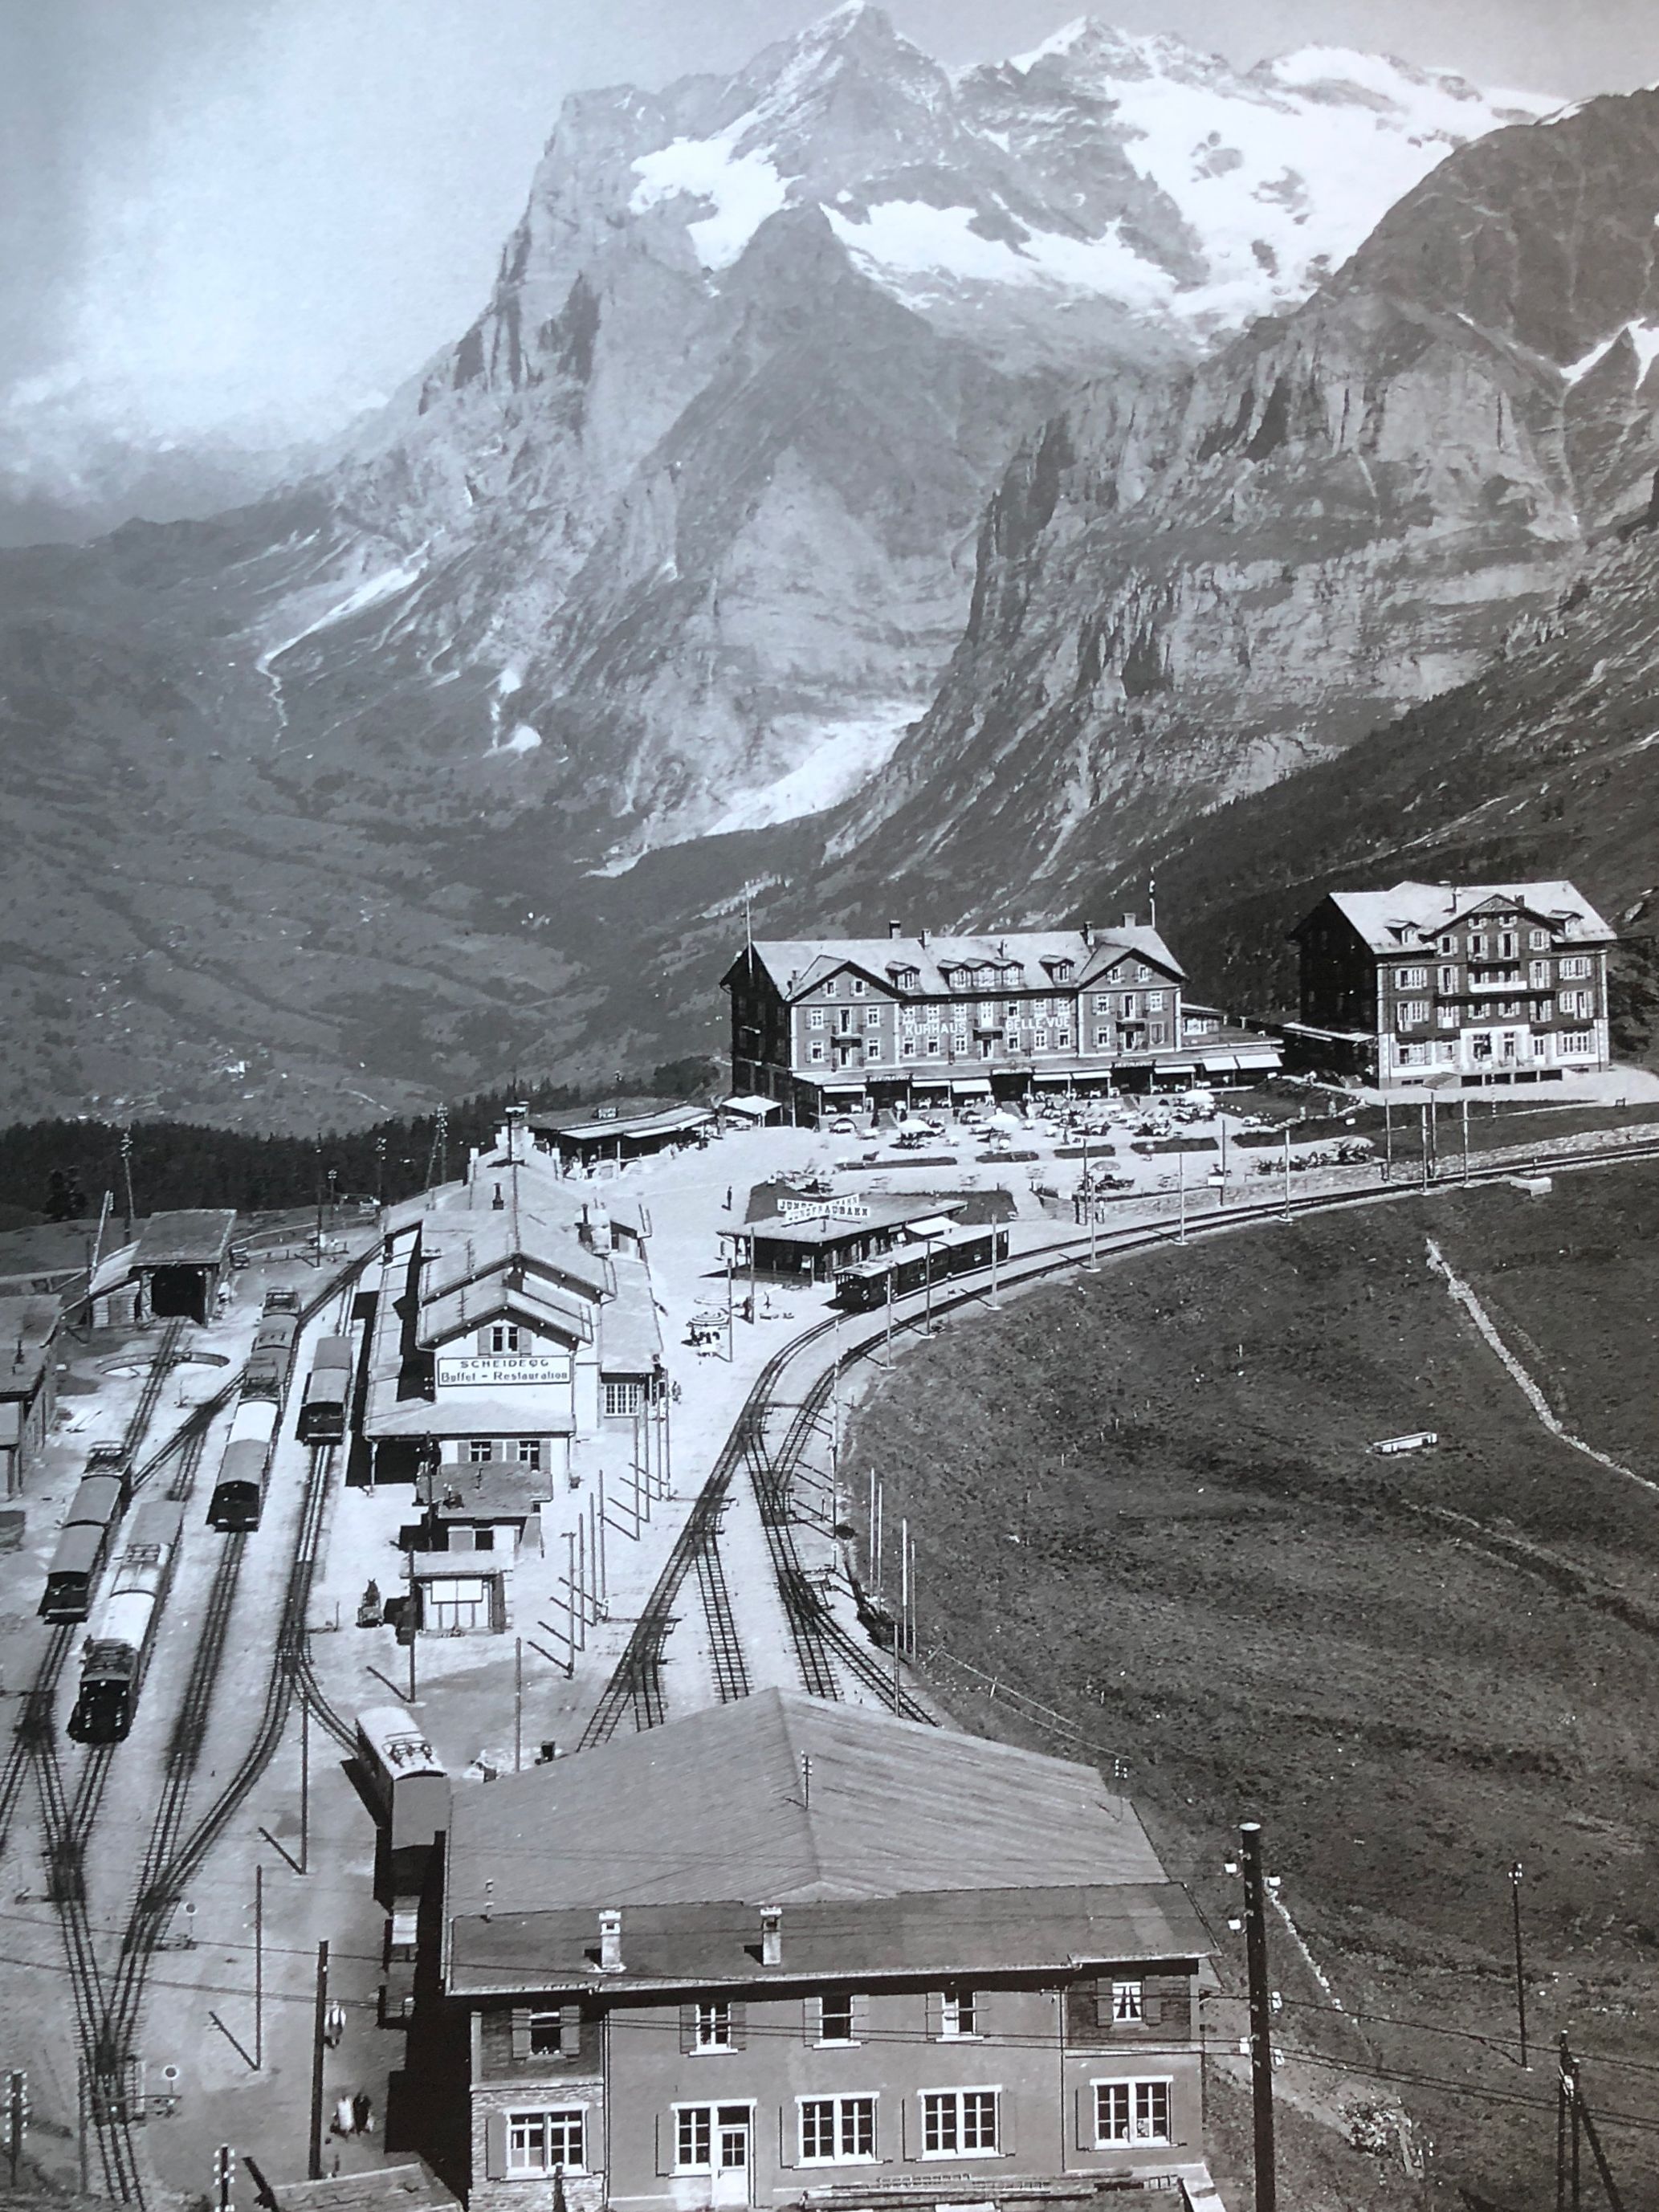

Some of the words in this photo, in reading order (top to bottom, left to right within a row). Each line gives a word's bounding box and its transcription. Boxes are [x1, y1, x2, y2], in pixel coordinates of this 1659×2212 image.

[905, 1022, 967, 1036] KURHAUS
[460, 1359, 549, 1368] SCHEIDEGG
[493, 1371, 569, 1381] Restauration
